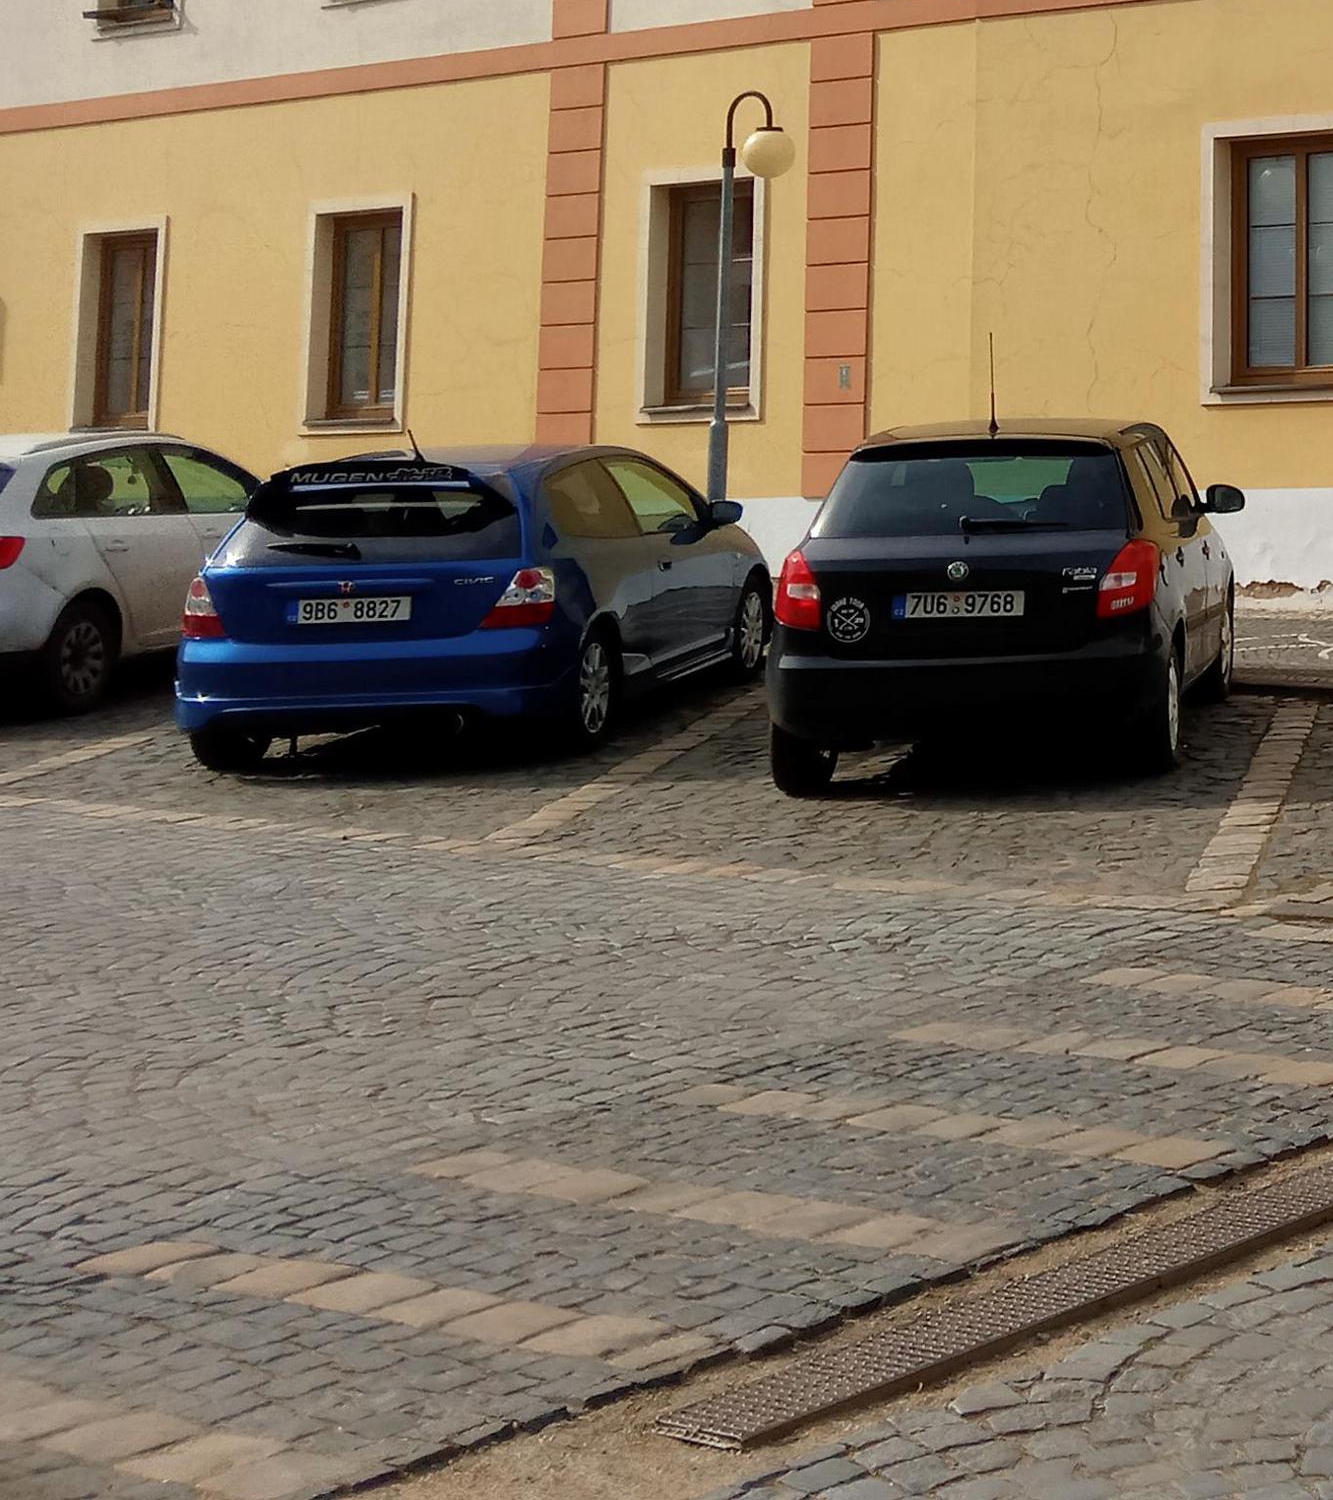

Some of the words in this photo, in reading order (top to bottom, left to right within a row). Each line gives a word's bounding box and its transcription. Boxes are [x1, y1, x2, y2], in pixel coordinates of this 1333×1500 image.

[290, 472, 384, 483] MUGEN
[453, 576, 494, 585] CIVIC
[302, 602, 338, 620] 9B6
[353, 600, 401, 619] 8827
[910, 594, 948, 615] 7U6
[964, 593, 1014, 614] 9768
